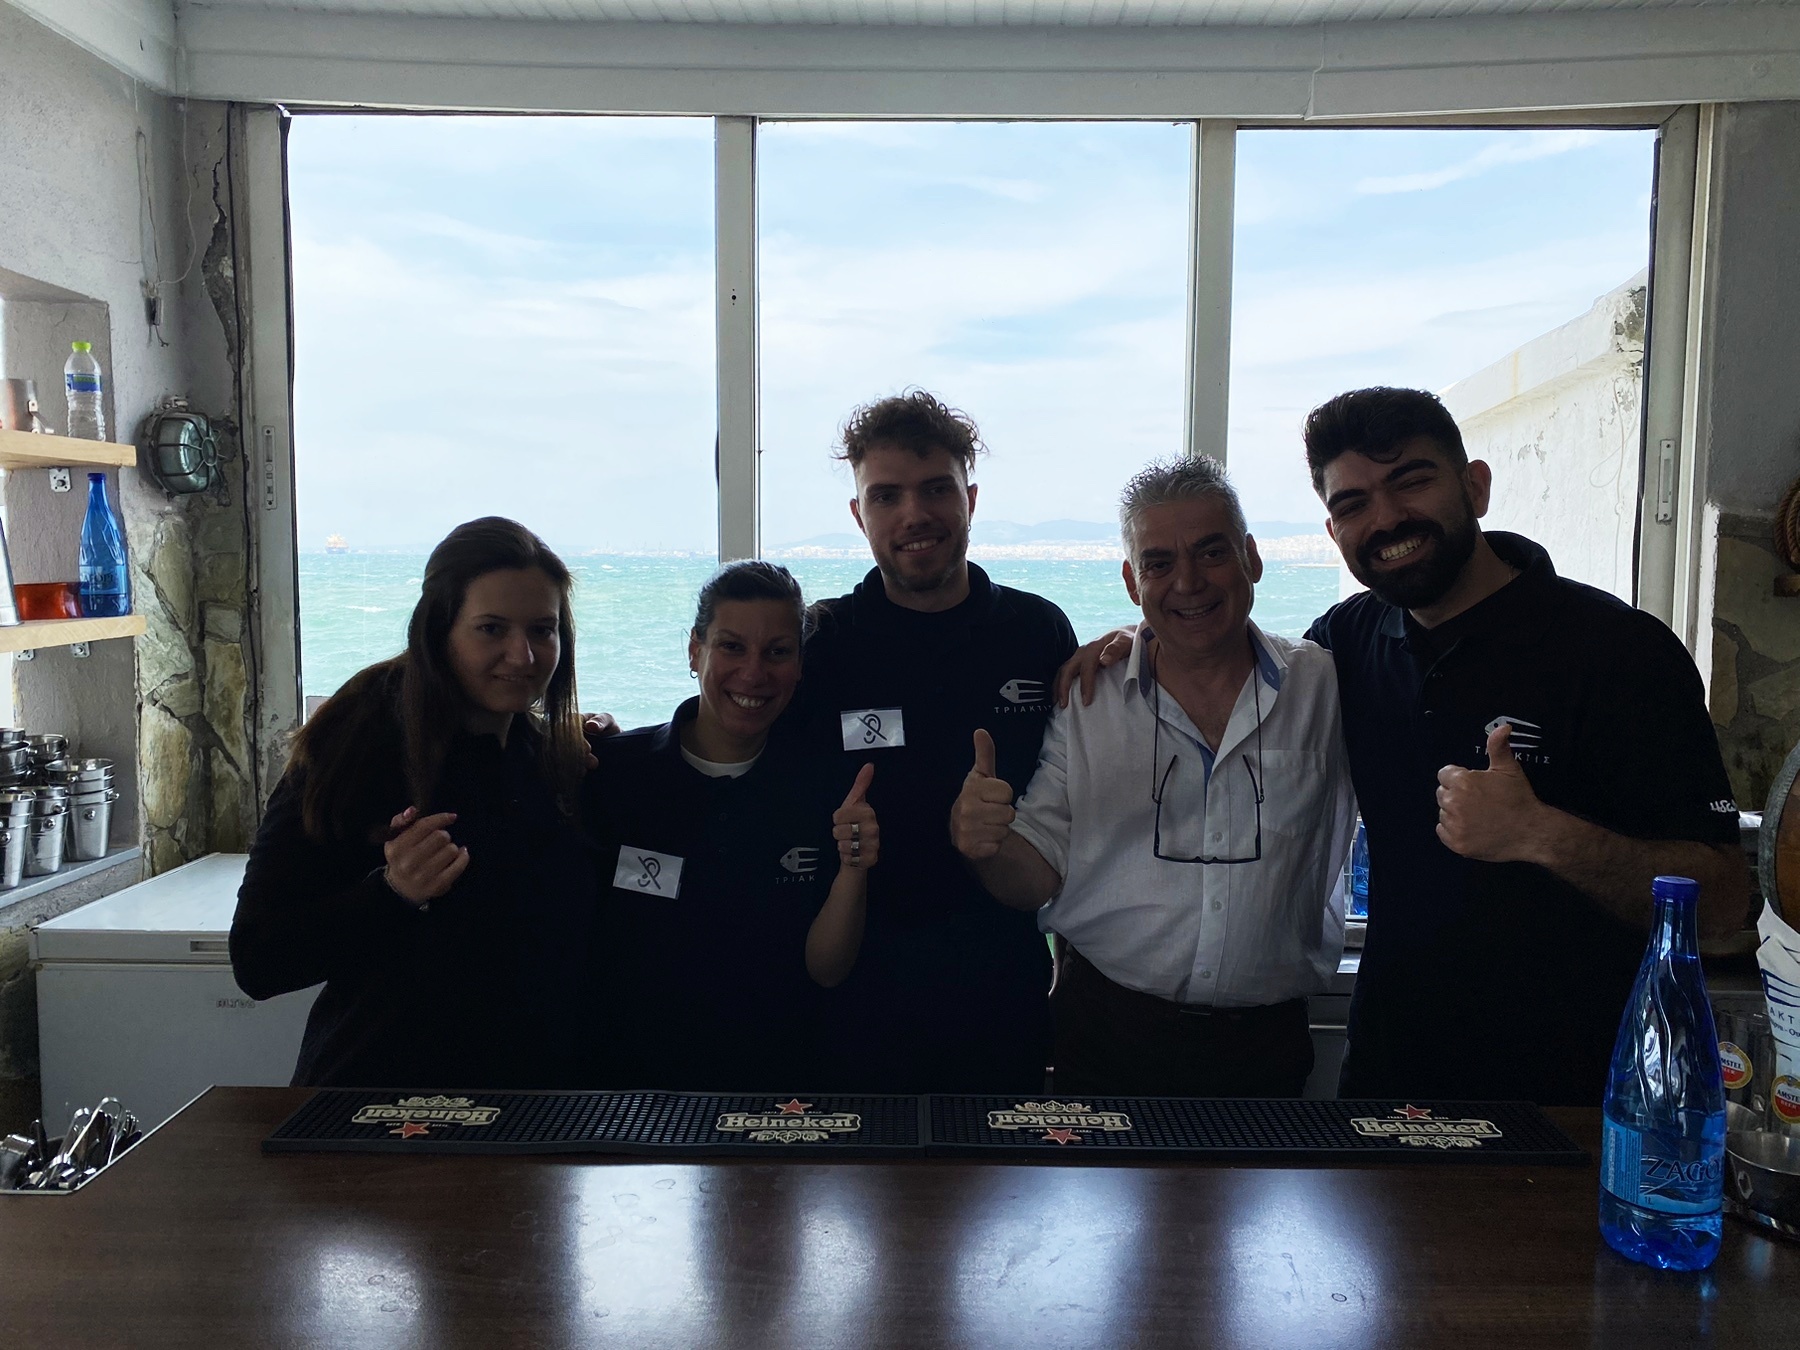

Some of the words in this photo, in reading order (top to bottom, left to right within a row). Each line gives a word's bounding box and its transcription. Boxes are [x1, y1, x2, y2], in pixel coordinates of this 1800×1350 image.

[1475, 745, 1551, 764] ΤΚΤΙΣ
[358, 1107, 493, 1122] Heineken
[995, 1114, 1124, 1127] Heineken
[724, 1116, 856, 1128] Heineken
[1358, 1121, 1493, 1134] Heineken
